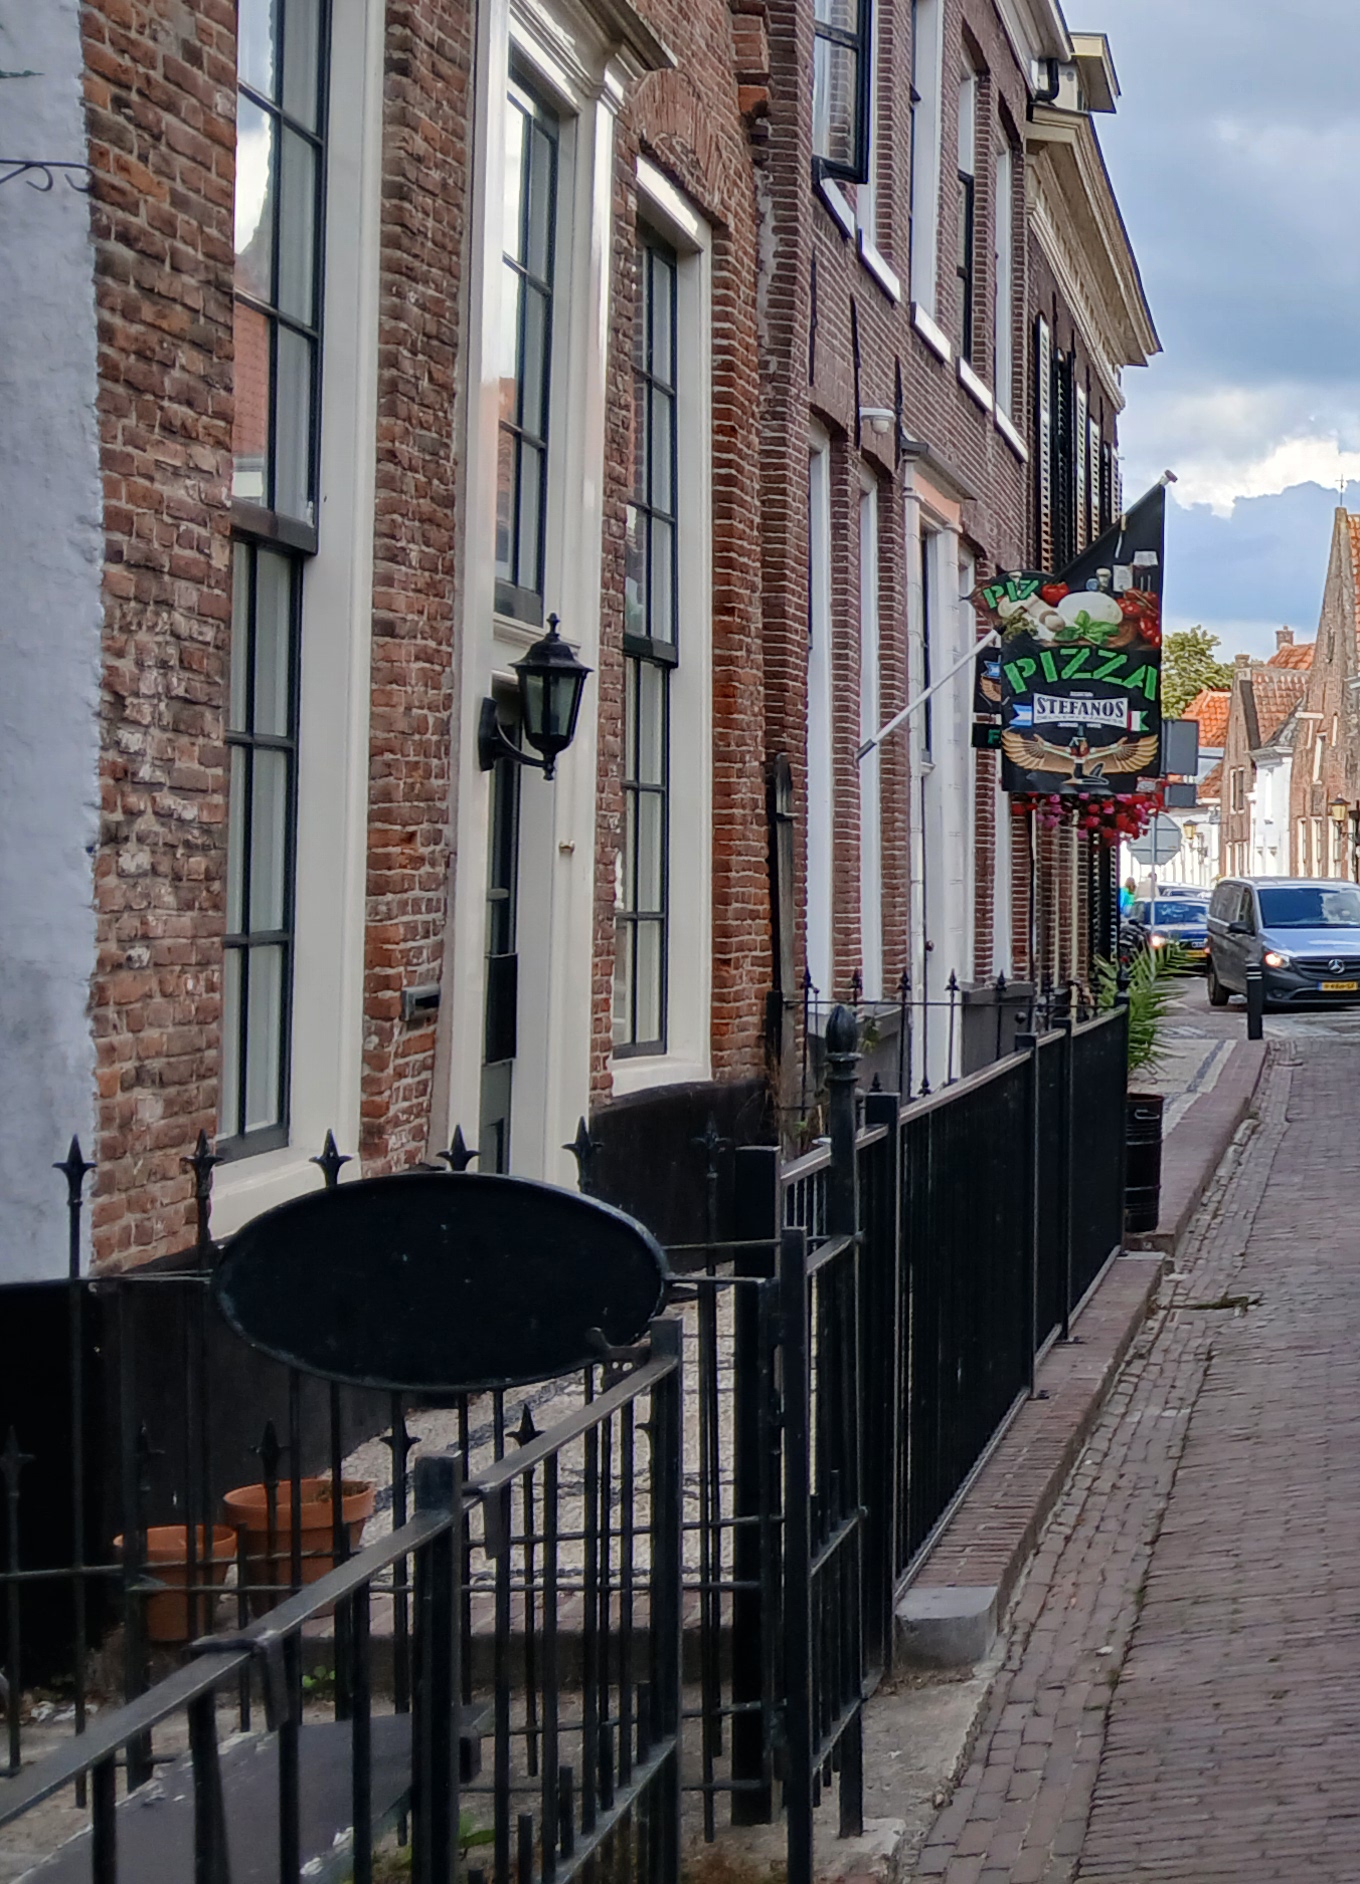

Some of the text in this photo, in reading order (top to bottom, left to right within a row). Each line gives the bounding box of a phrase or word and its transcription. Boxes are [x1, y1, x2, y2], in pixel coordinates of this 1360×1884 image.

[983, 580, 1038, 608] PIZ
[1003, 648, 1157, 700] PIZZA
[1036, 696, 1124, 718] STEFANOS
